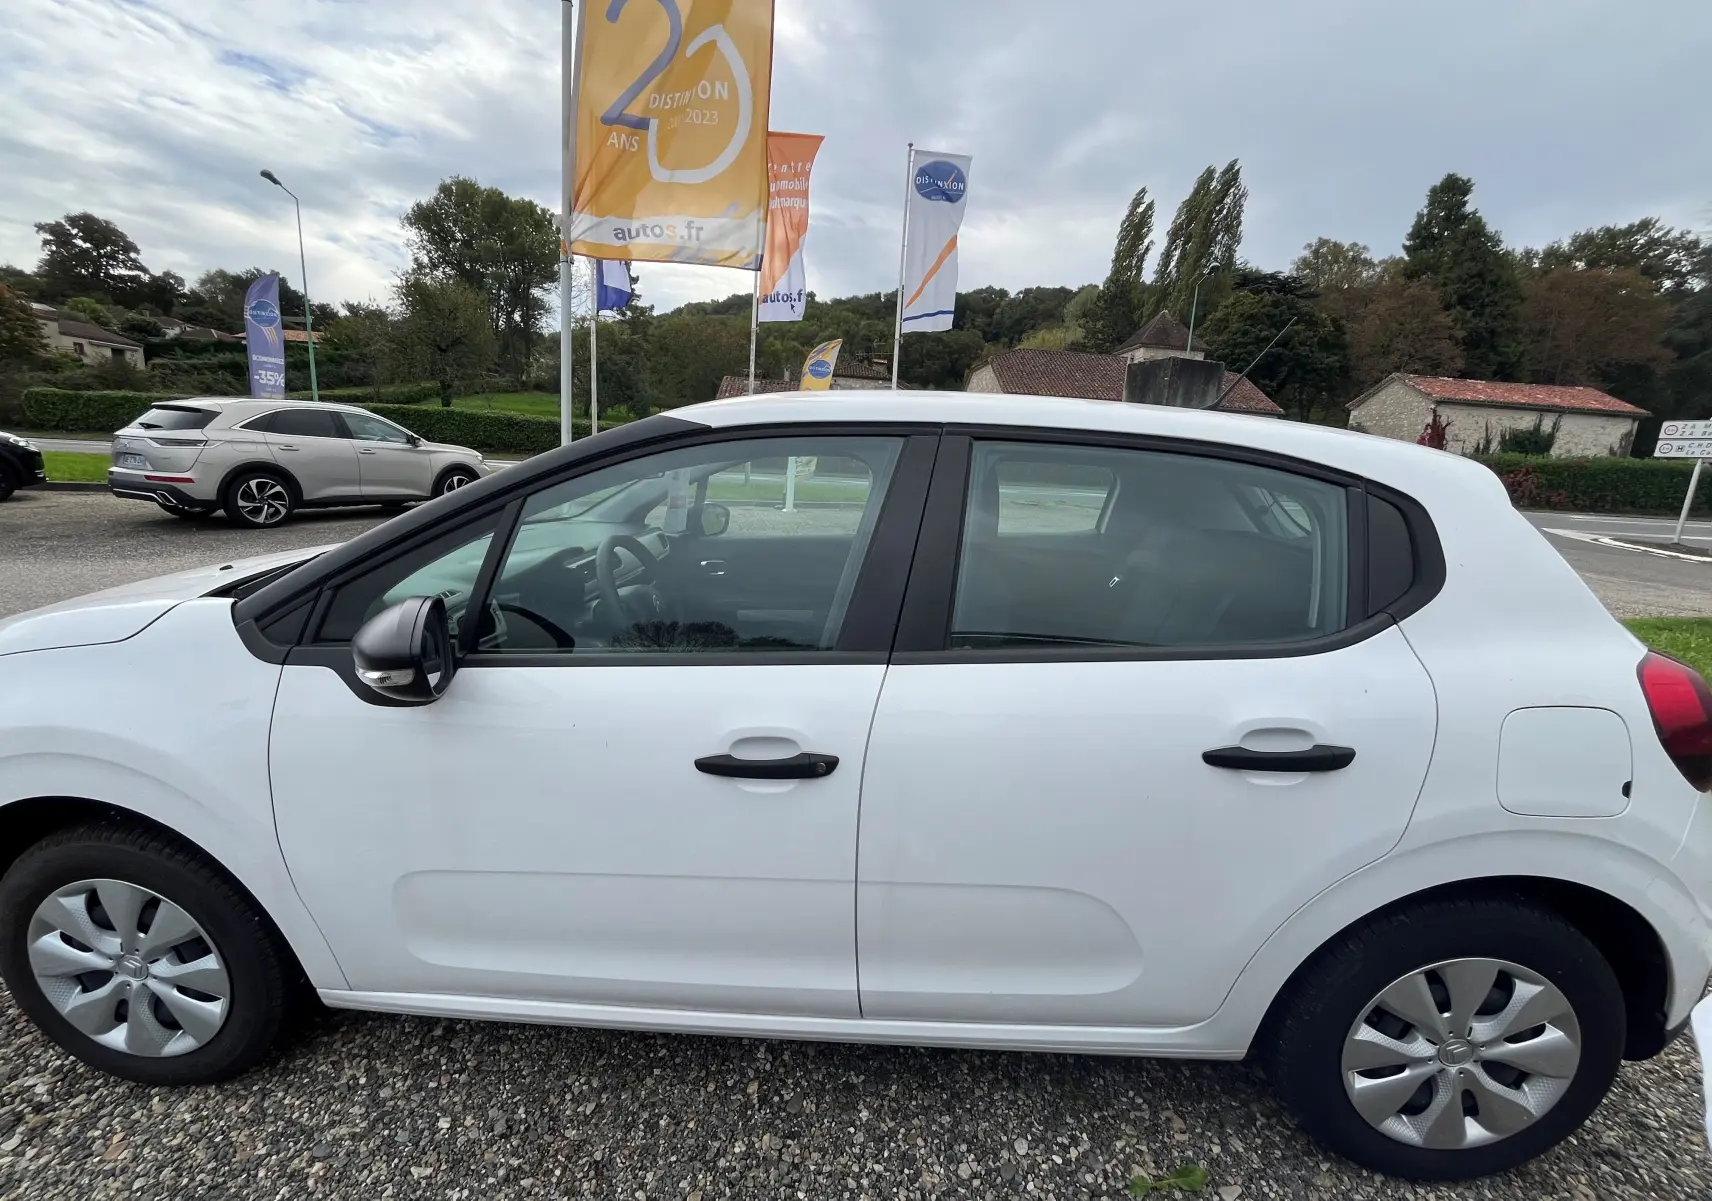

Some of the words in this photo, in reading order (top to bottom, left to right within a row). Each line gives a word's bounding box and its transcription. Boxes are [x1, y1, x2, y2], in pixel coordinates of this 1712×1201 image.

[607, 131, 640, 151] ANS
[613, 220, 704, 242] autos.fr
[762, 289, 803, 304] autos.f
[254, 370, 284, 387] -35%
